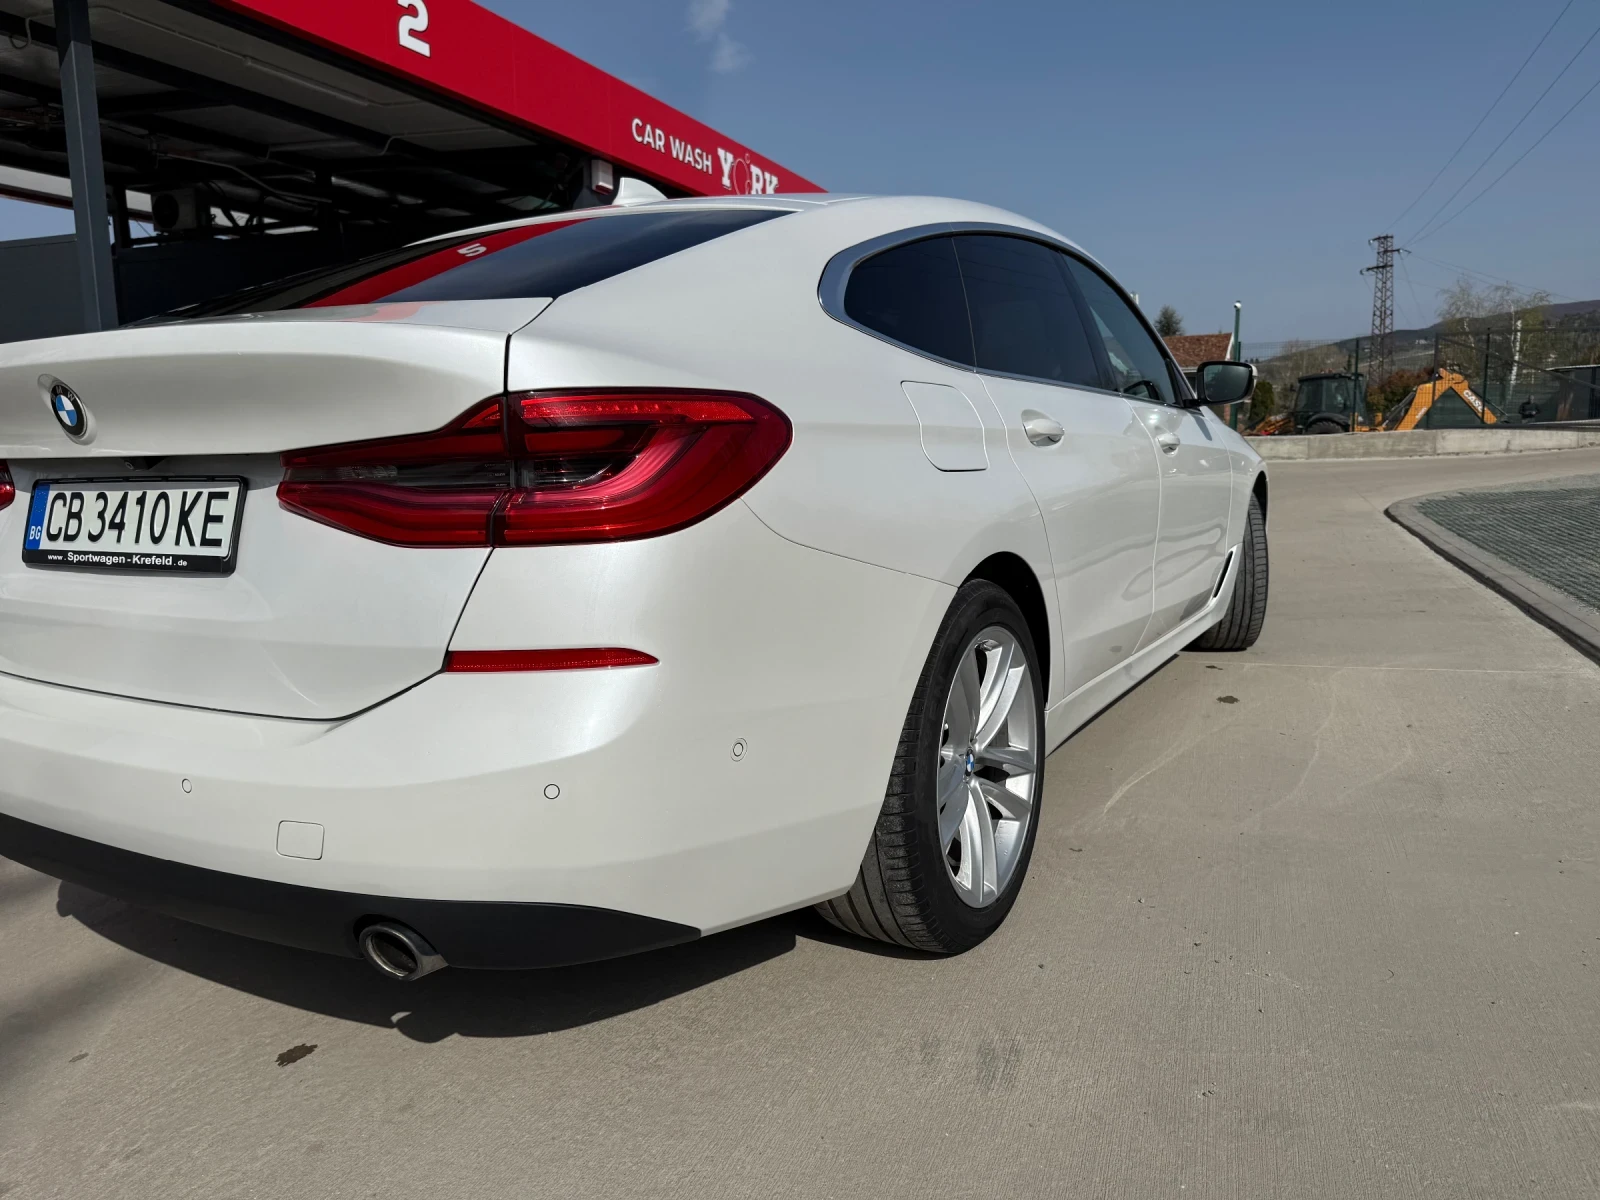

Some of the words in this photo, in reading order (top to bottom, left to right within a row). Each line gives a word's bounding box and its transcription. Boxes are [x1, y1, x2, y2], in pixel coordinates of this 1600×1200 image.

[397, 0, 431, 58] 2
[632, 118, 665, 153] CAR
[669, 136, 713, 174] WASH
[29, 525, 41, 540] BG
